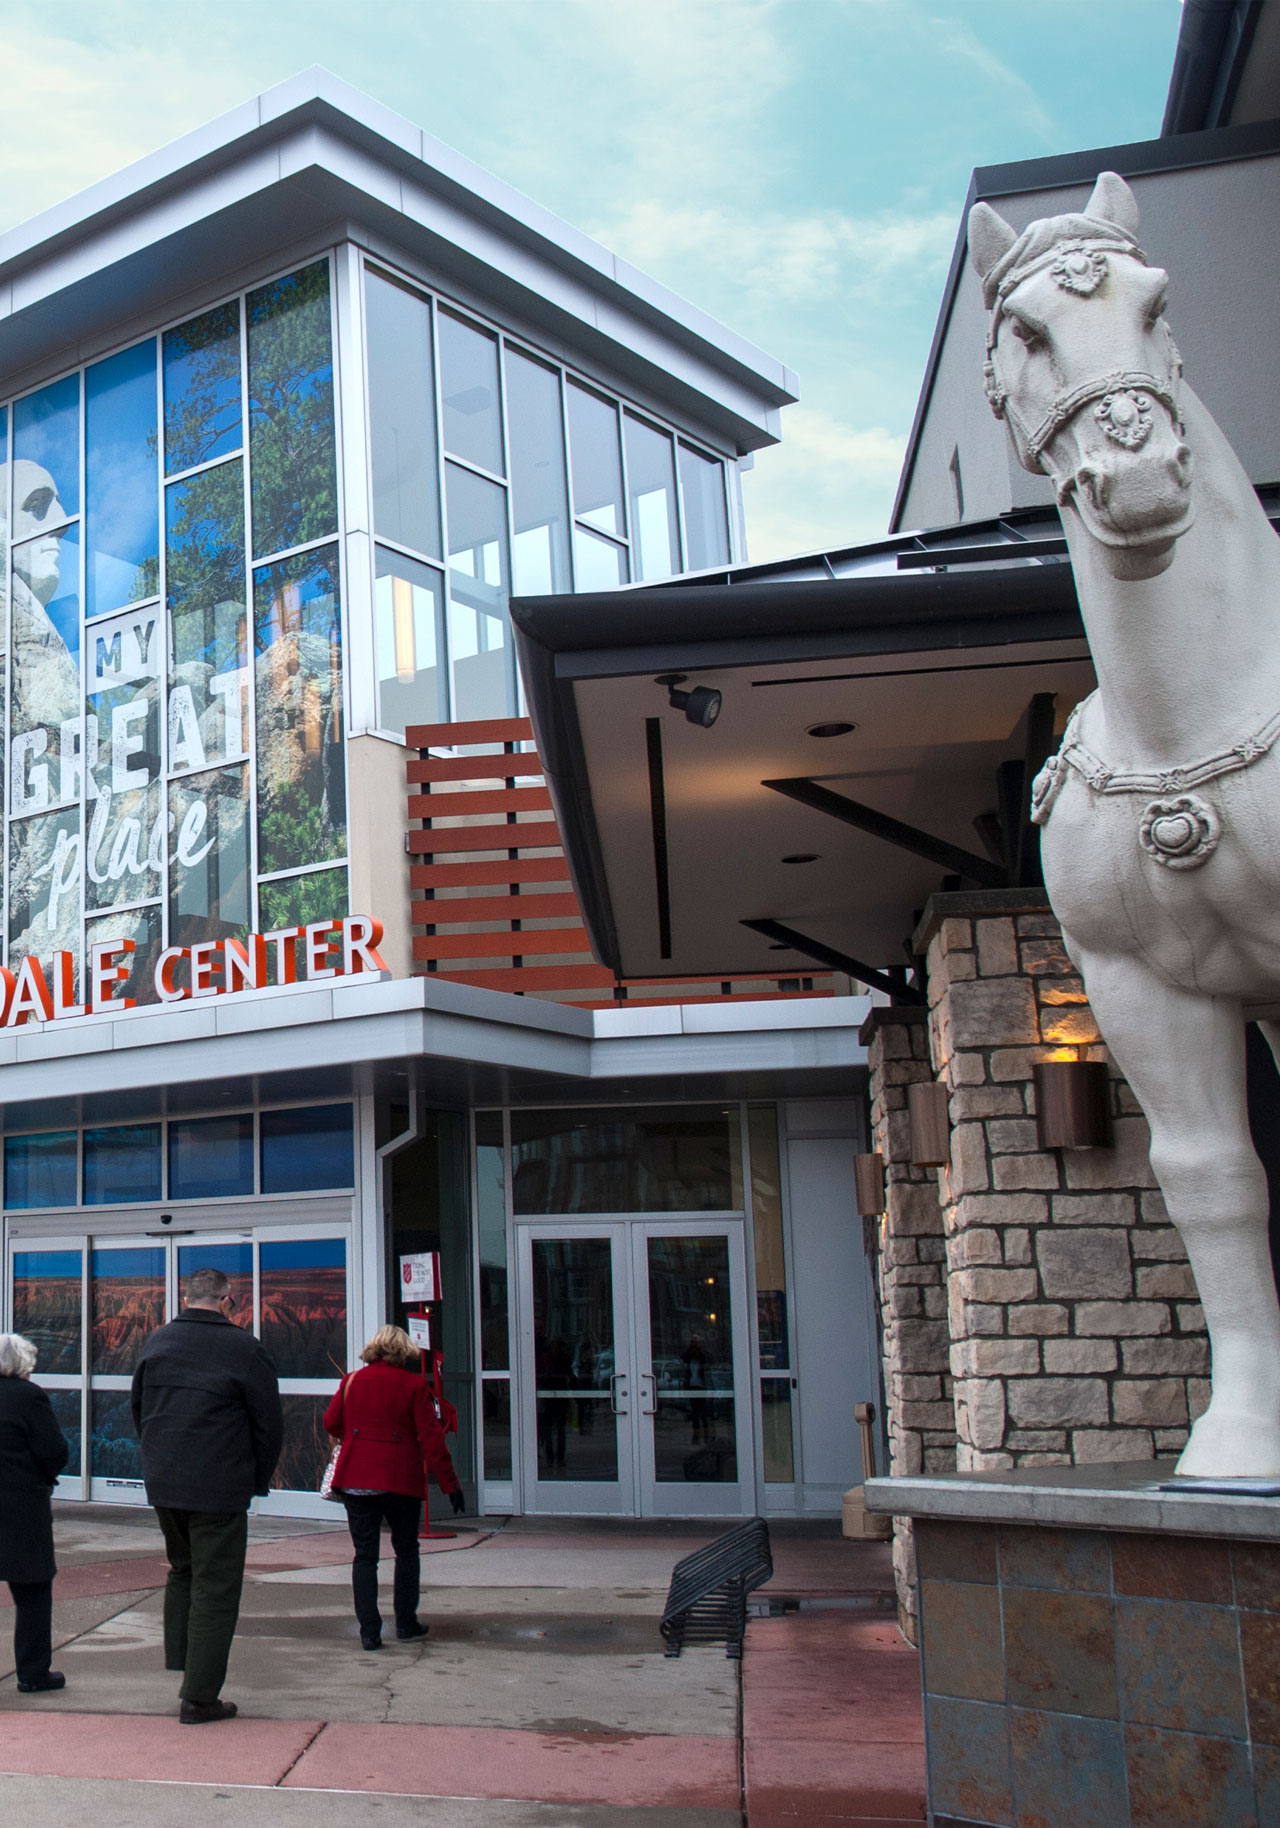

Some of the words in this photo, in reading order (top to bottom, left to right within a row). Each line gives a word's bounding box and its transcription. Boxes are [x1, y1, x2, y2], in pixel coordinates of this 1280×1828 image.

[96, 620, 156, 677] MY
[10, 667, 250, 814] GREAT
[32, 785, 216, 931] place
[154, 914, 389, 1003] CENTER
